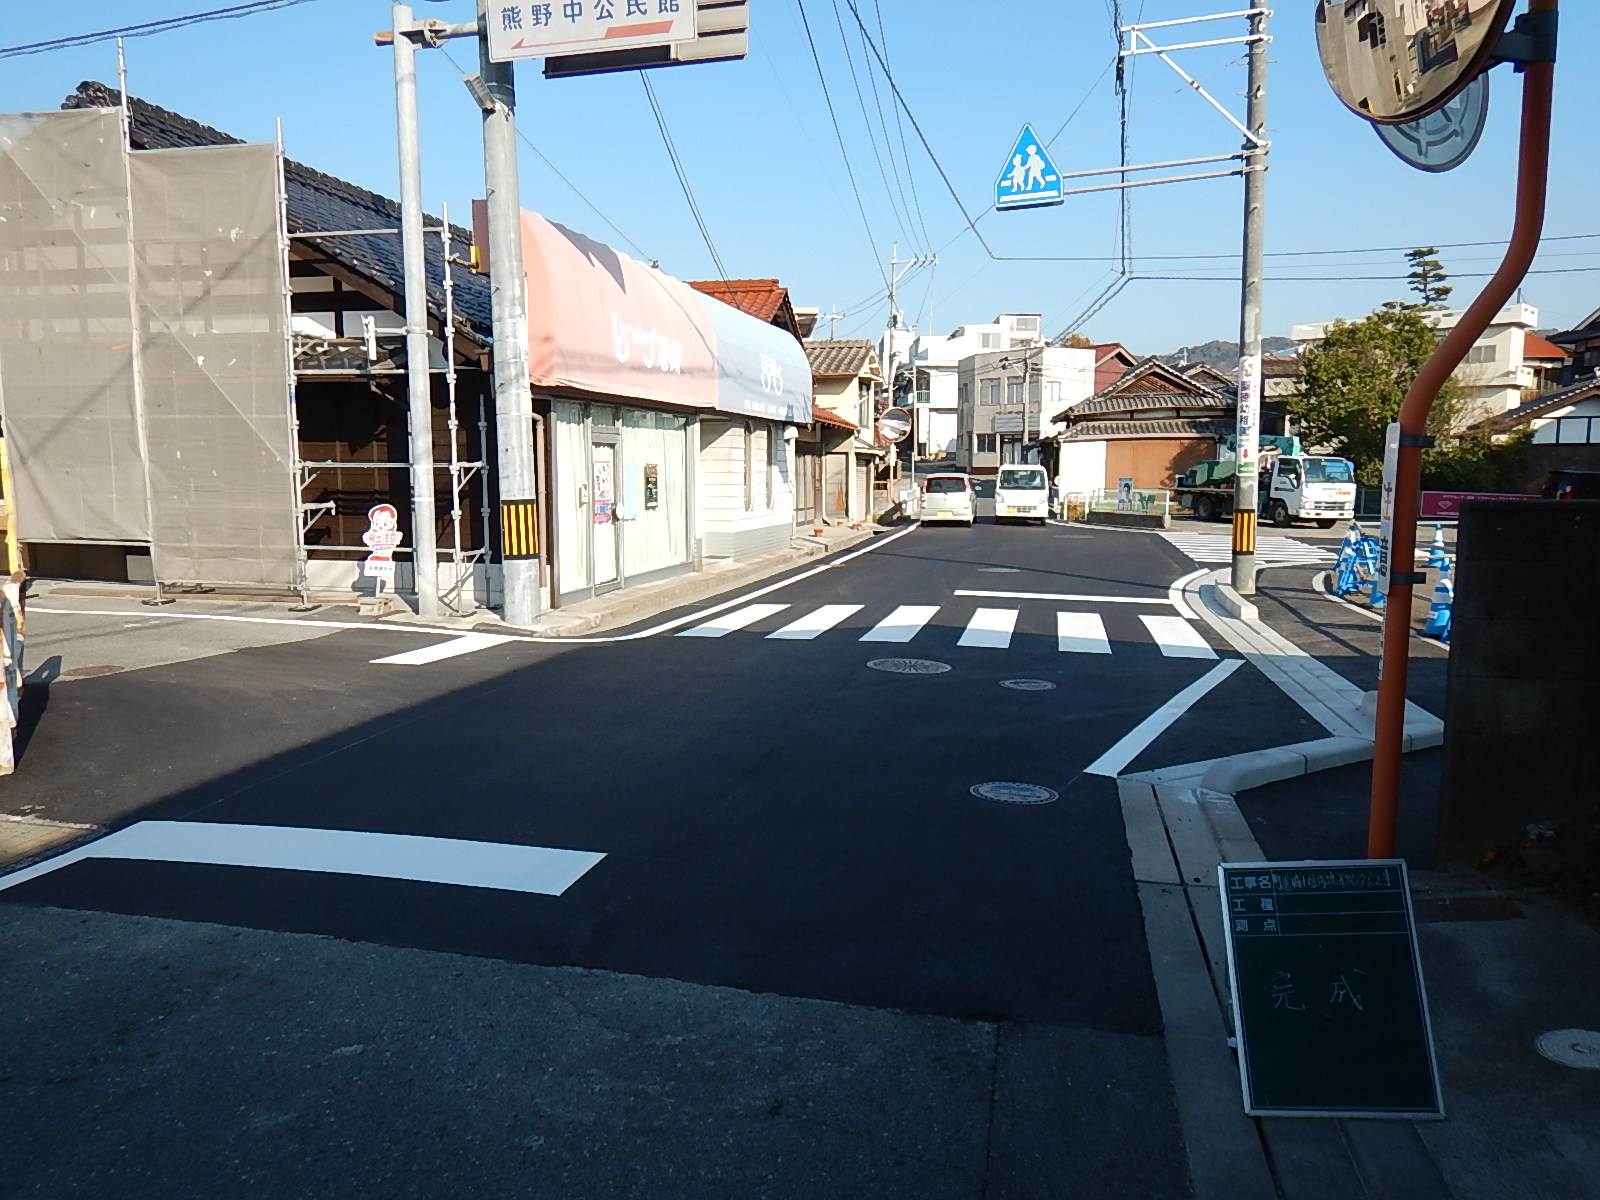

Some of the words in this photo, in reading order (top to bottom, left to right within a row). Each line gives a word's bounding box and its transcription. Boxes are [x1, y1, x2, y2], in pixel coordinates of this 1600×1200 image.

[1230, 875, 1272, 889] 工事名
[1235, 919, 1277, 932] 測点
[1271, 968, 1369, 1011] 完成
